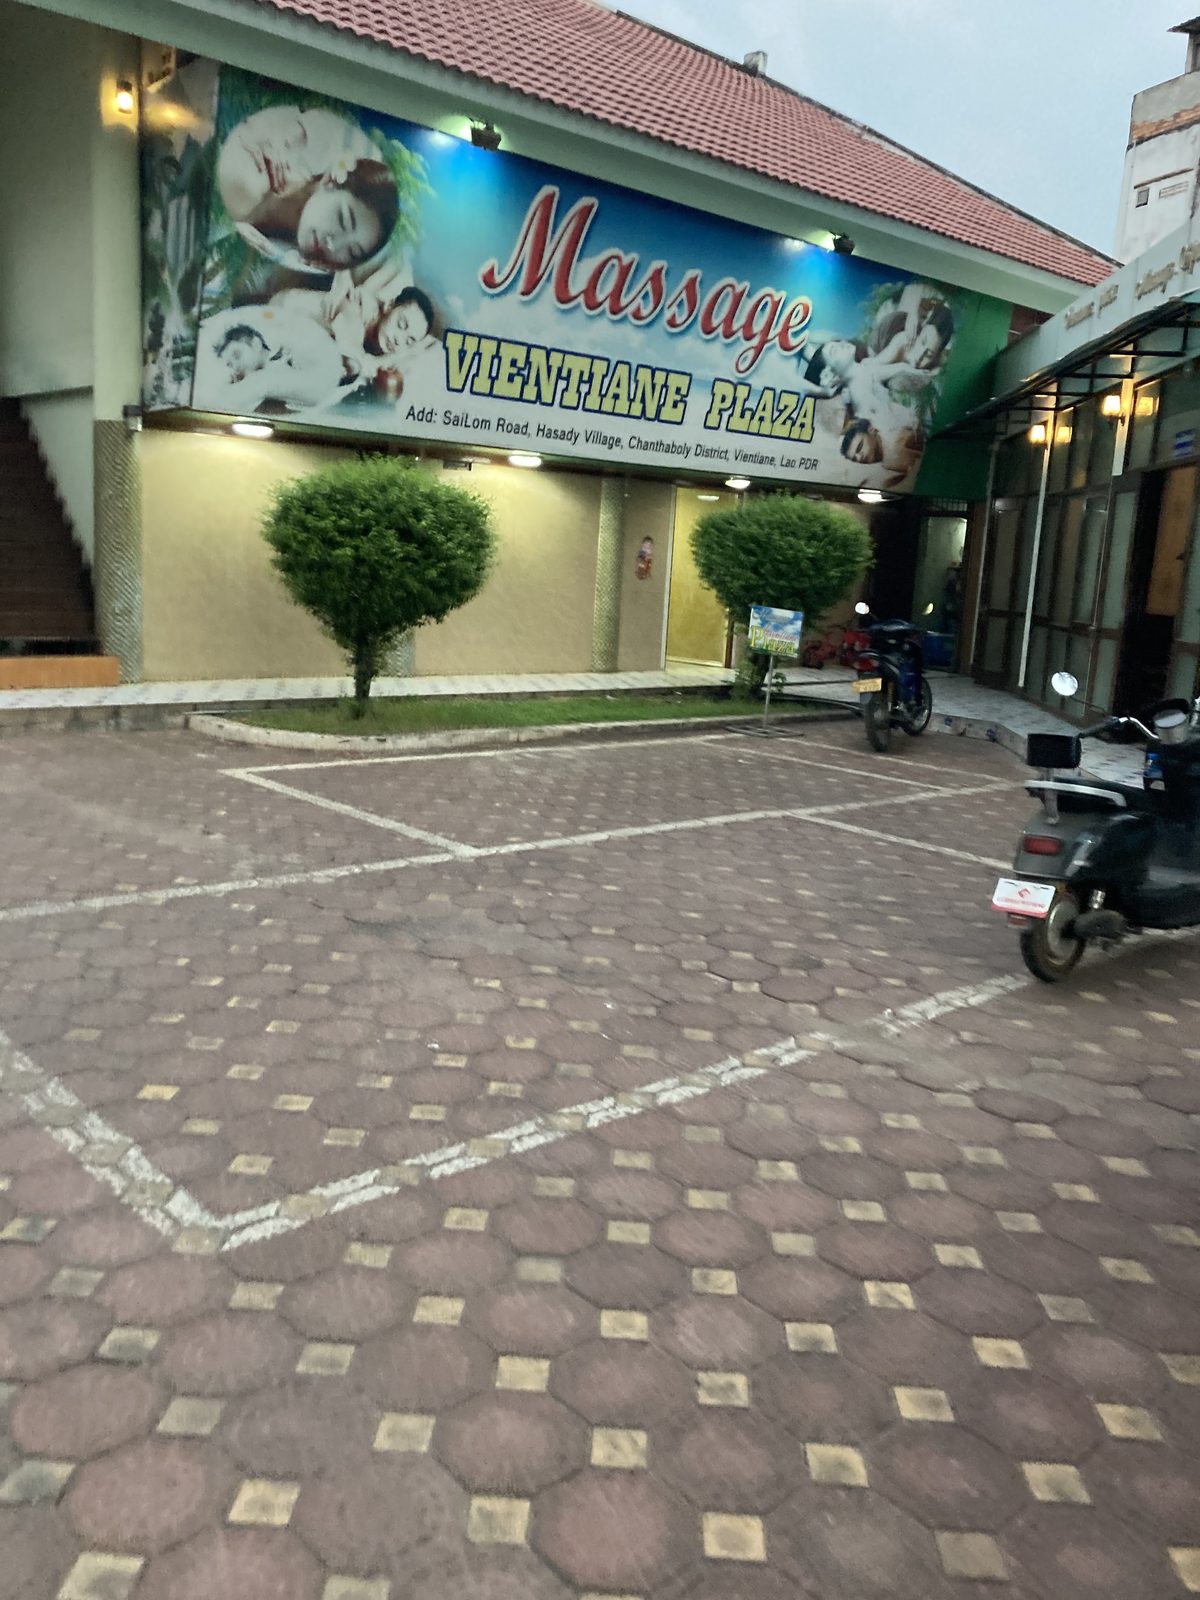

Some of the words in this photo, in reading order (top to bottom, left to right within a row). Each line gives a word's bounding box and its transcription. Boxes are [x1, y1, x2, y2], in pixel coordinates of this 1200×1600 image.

[481, 184, 811, 378] Massage
[406, 405, 437, 424] Add:
[442, 410, 491, 431] SaiLom
[496, 417, 531, 438] Road,
[536, 424, 580, 446] Hasady
[585, 430, 624, 450] Village,
[628, 435, 692, 459] Chanthaboly
[694, 444, 730, 462] District,
[734, 449, 777, 467] Vientiane,
[780, 455, 796, 468] Lao
[799, 457, 819, 471] PDR
[444, 329, 692, 426] VIENTIANE
[704, 377, 817, 444] PLAZA
